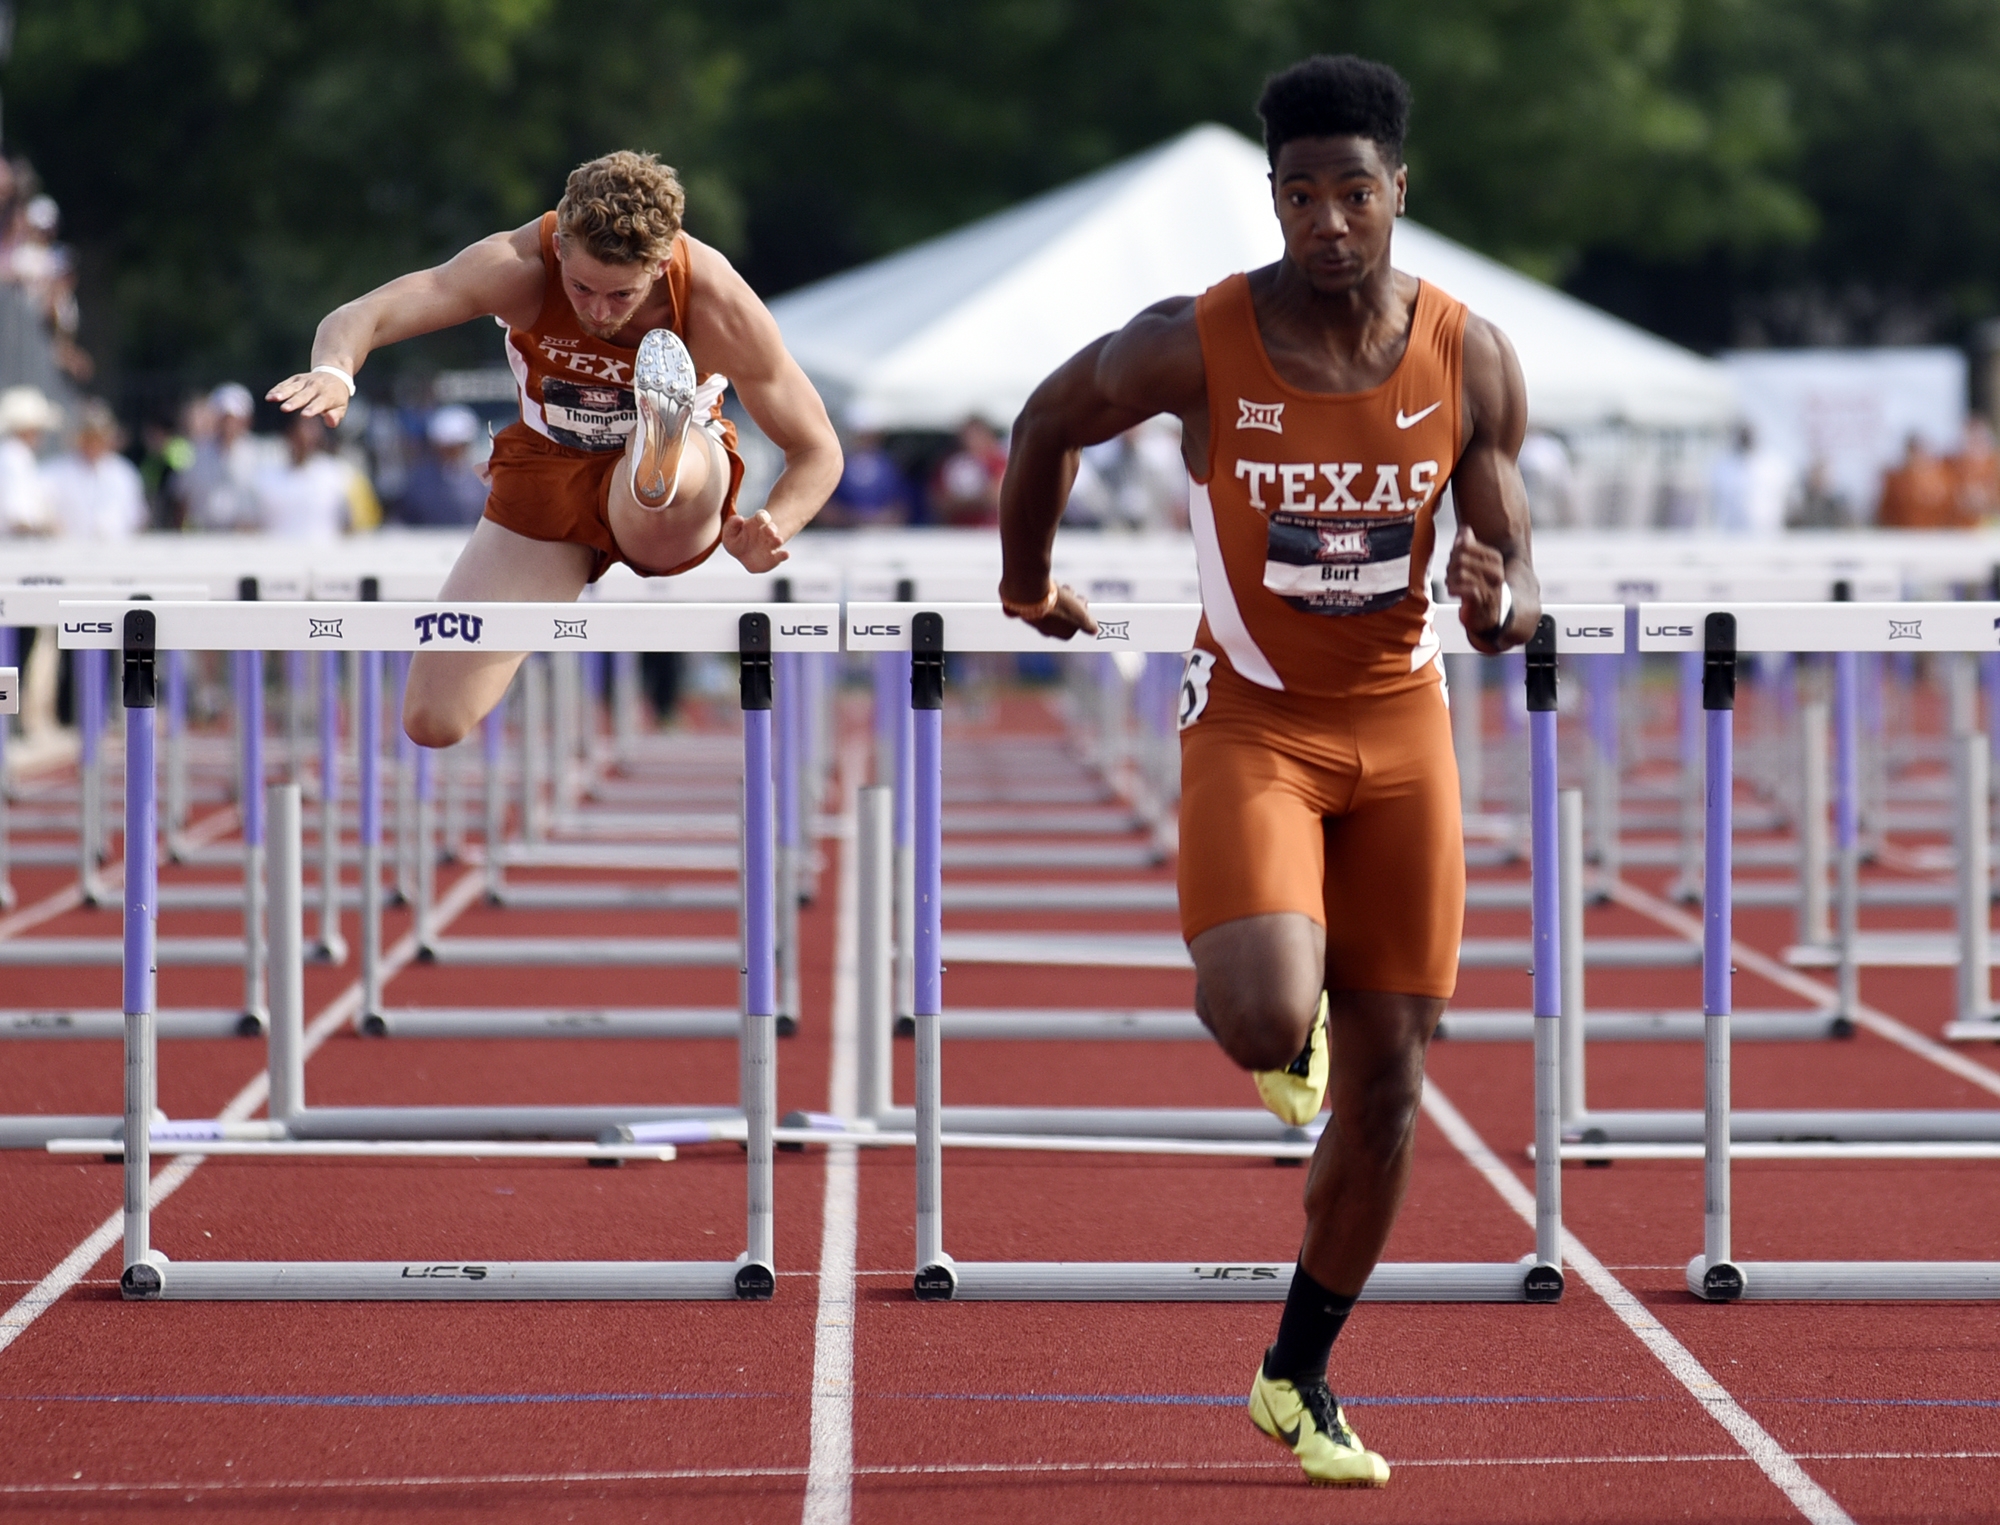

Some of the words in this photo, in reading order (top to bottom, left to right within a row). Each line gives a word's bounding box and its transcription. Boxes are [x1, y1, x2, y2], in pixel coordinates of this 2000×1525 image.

[538, 344, 636, 387] TEX
[564, 408, 638, 427] Thompson
[1235, 459, 1439, 512] TEXAS
[1321, 566, 1360, 581] Burt
[64, 622, 113, 633] UCS
[414, 612, 483, 645] TCU
[780, 625, 829, 636] UCS
[853, 625, 901, 636] UCS
[1566, 627, 1614, 638] UCS
[1646, 626, 1694, 637] UCS
[402, 1266, 488, 1280] UCS
[918, 1281, 950, 1289] UCS
[1528, 1282, 1560, 1290] UCS
[1708, 1280, 1739, 1288] UCS
